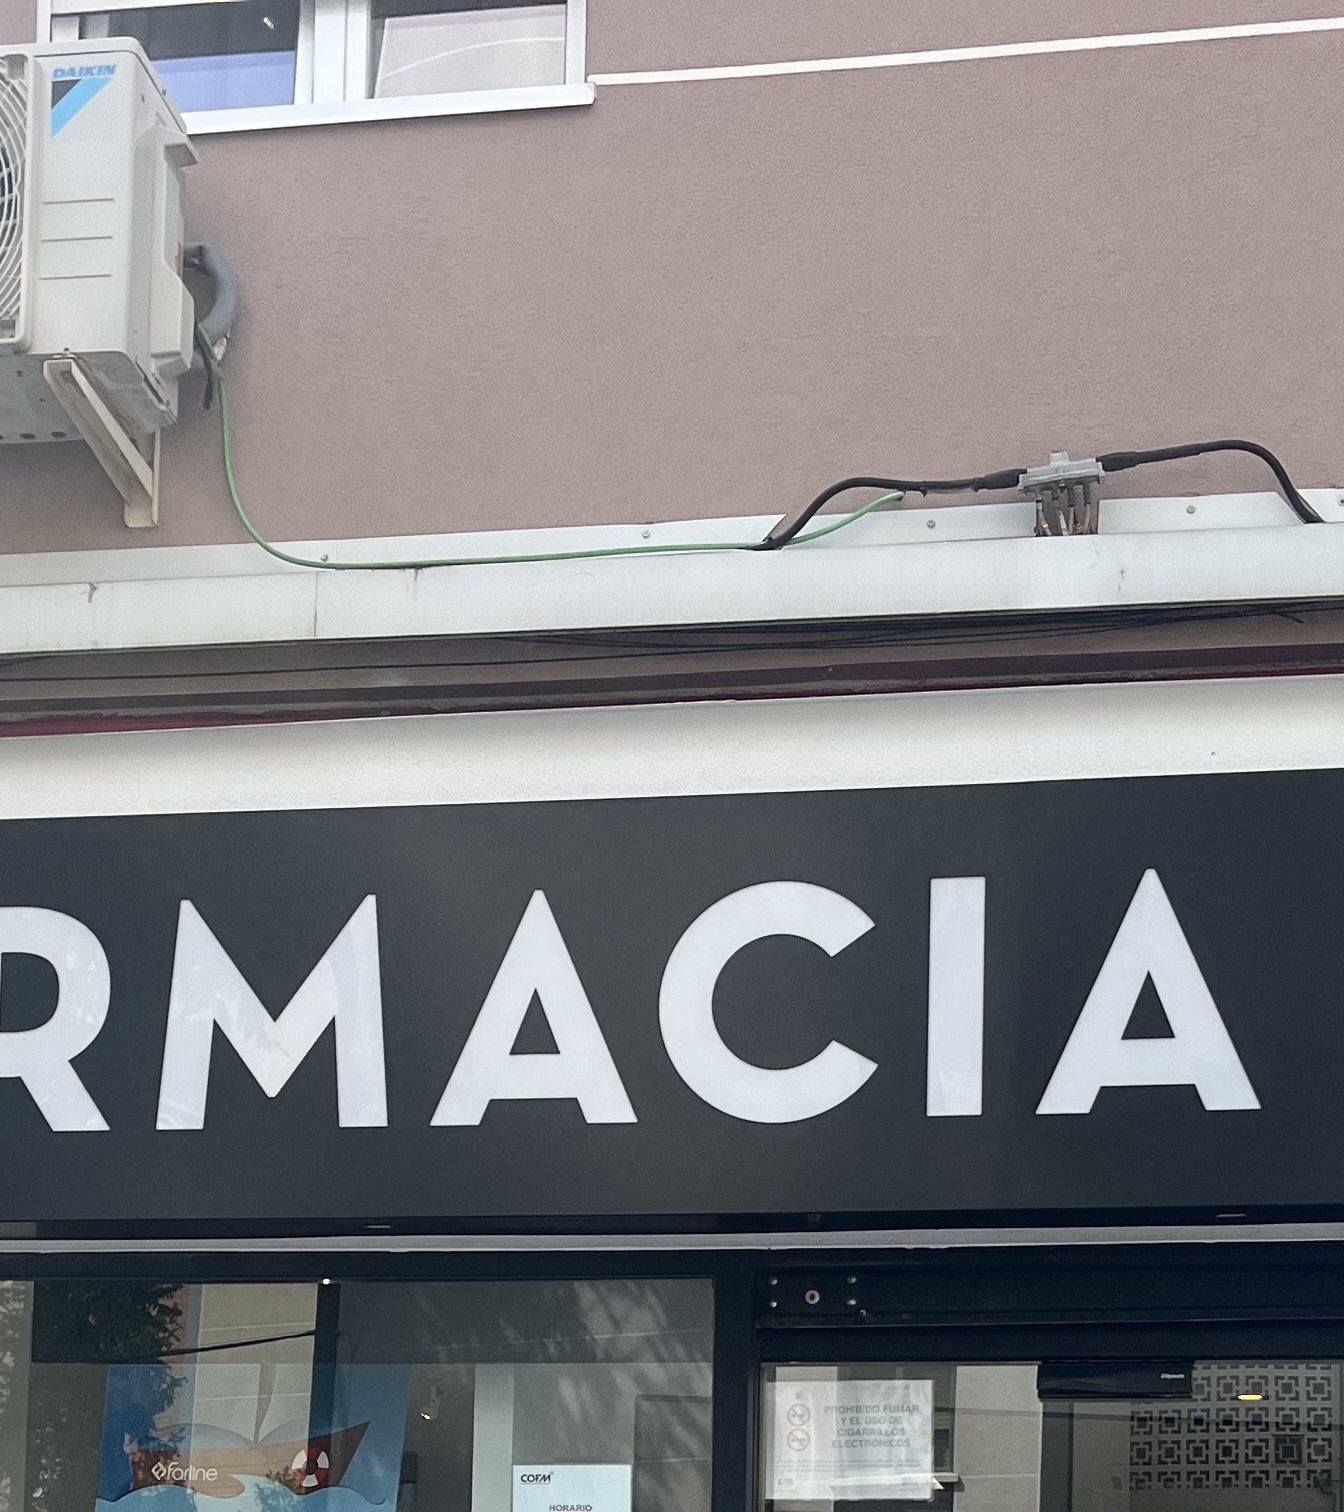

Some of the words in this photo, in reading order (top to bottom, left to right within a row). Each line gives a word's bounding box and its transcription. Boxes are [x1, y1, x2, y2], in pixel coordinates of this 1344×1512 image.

[52, 64, 117, 79] DAIKIN
[824, 1404, 880, 1414] PROHIBIDO
[883, 1404, 919, 1413] FUMAR
[840, 1416, 848, 1425] Y
[849, 1416, 862, 1425] EL
[864, 1416, 886, 1425] USO
[837, 1427, 906, 1437] CIGARRILLOS
[831, 1438, 911, 1449] ELECTRÓNICOS
[167, 1461, 218, 1481] farline
[520, 1473, 551, 1483] COFM
[548, 1504, 593, 1512] HORARIO
